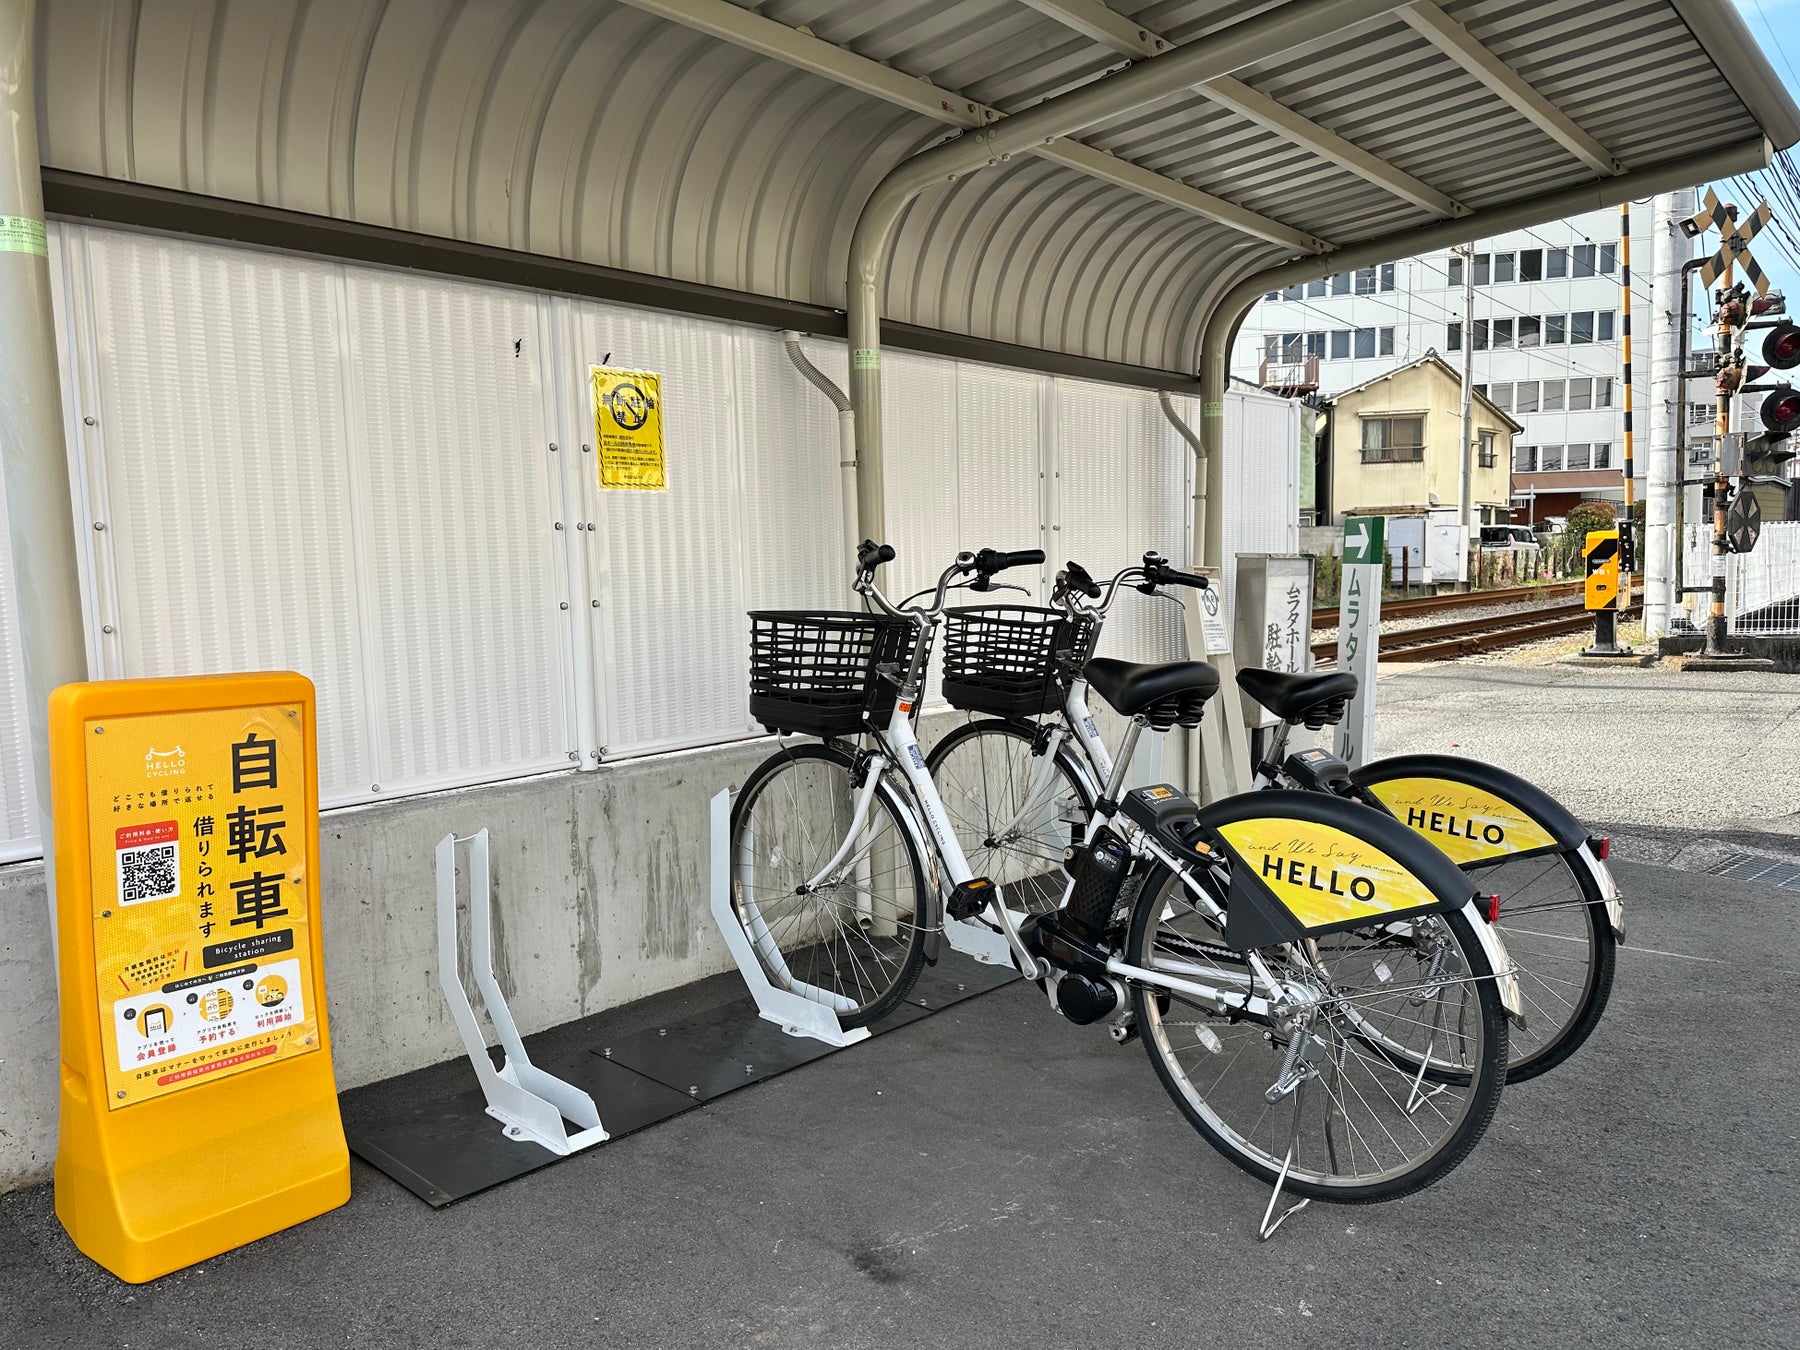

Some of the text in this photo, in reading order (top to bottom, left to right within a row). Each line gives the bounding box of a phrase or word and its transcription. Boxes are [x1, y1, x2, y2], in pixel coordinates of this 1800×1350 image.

[1286, 582, 1301, 673] ムラタホール
[1341, 568, 1362, 762] ムラタール
[146, 759, 185, 770] HELLO
[147, 768, 186, 778] CYCLING
[113, 783, 214, 803] どこでも借りられて
[113, 793, 214, 813] 好きな場所で返せる
[1395, 794, 1495, 815] and We Say
[226, 732, 289, 930] 自転車
[924, 799, 946, 846] HELLO CYCLING
[1407, 807, 1505, 845] HELLO
[1248, 838, 1364, 864] and We Say
[193, 815, 216, 938] 借りられます
[1262, 854, 1376, 901] HELLO
[215, 935, 282, 955] Bicycle sharing
[234, 947, 265, 959] station
[257, 1012, 292, 1028] 利用開始
[199, 1028, 236, 1044] 予約する
[136, 1031, 292, 1080] 自転車はマナーを守って安全に走行しましょう
[137, 1044, 177, 1061] 会員登録
